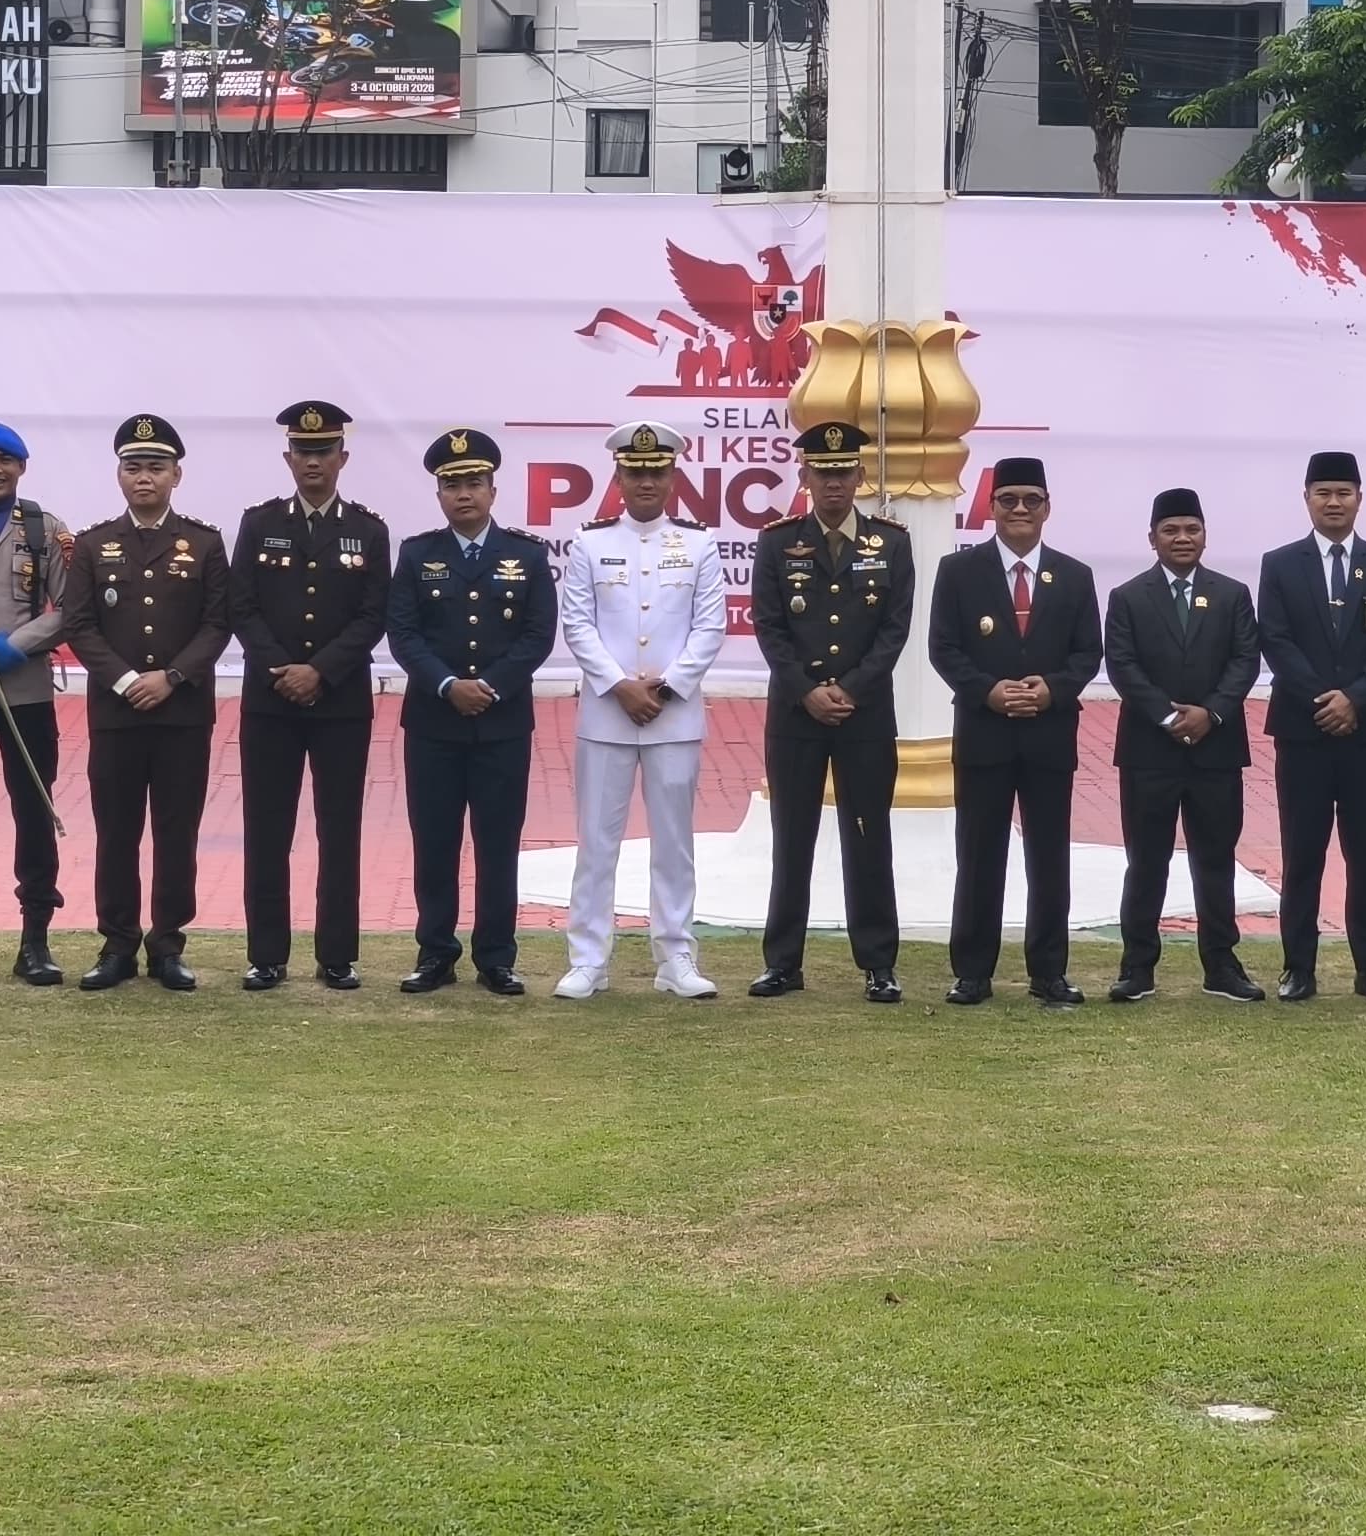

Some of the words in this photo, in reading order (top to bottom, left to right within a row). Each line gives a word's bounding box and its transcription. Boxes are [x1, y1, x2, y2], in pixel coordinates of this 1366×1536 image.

[350, 82, 367, 92] 3-4
[369, 83, 409, 93] OCTOBER
[703, 407, 789, 430] SELA
[15, 543, 48, 556] POI
